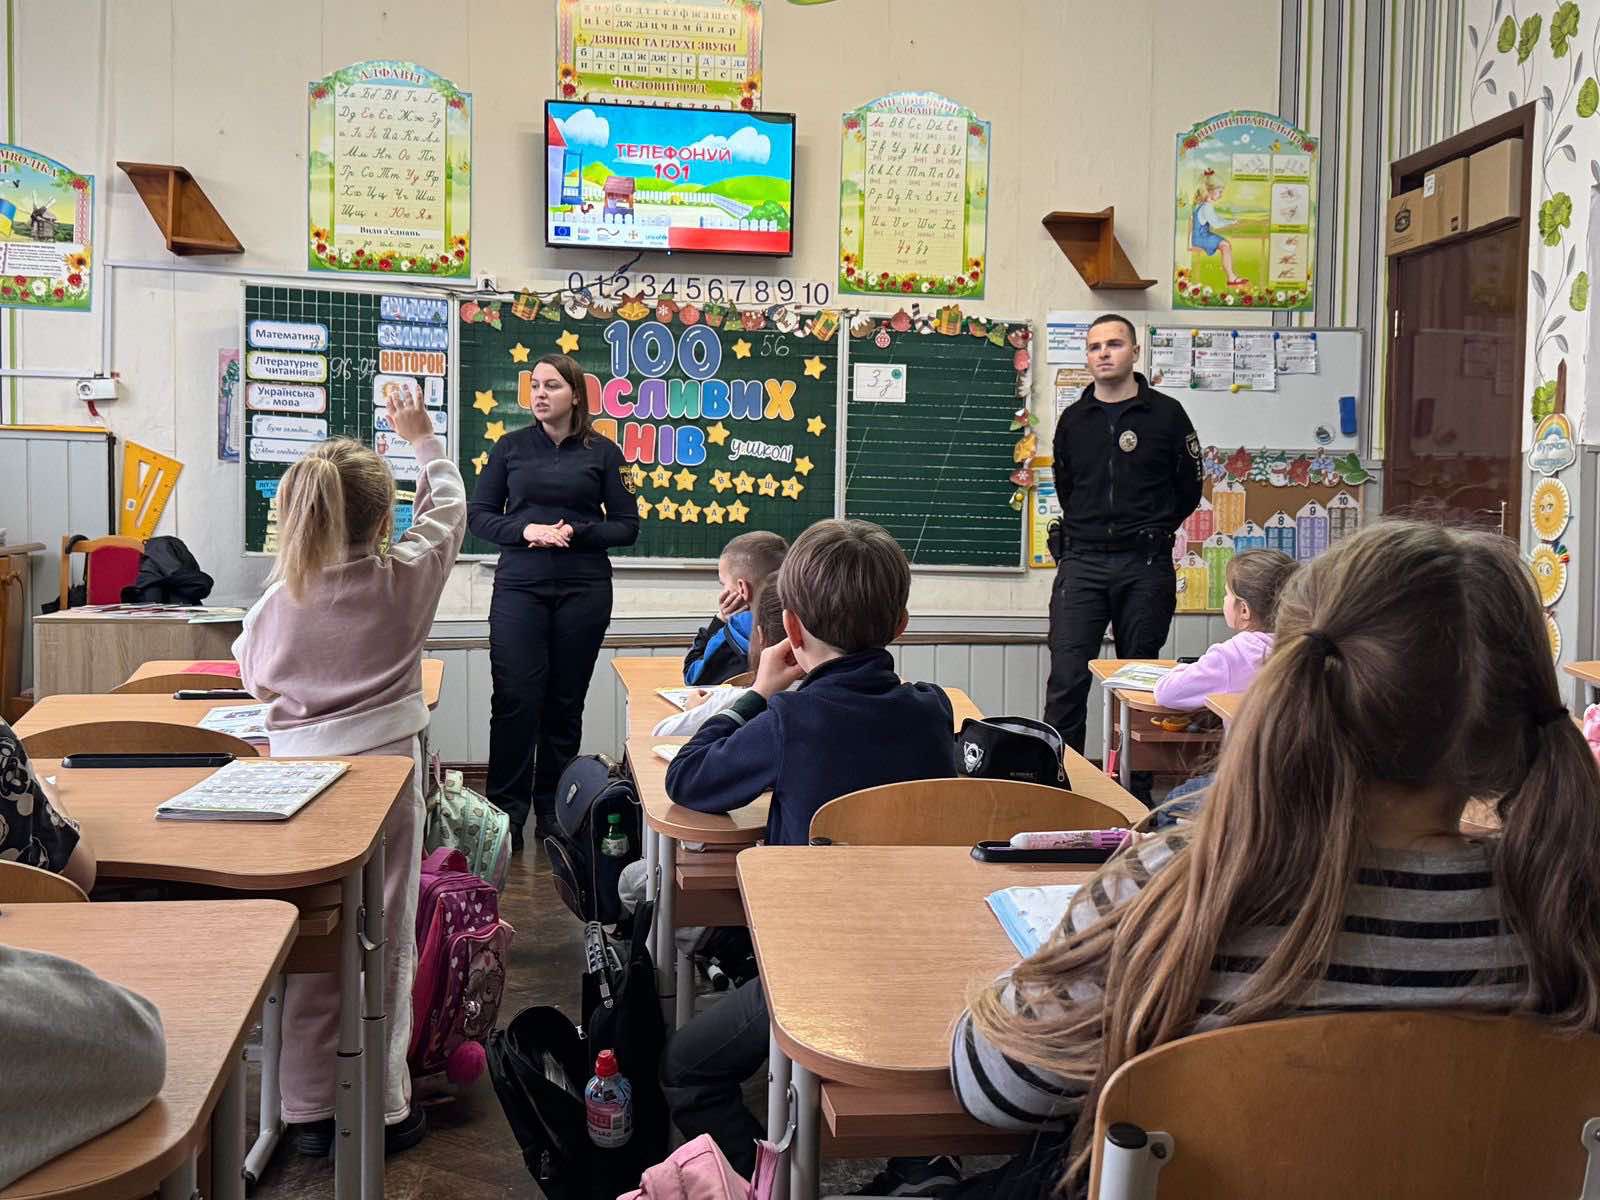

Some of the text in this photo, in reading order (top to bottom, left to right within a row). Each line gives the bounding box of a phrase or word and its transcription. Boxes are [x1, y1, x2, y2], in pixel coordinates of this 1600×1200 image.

[643, 38, 657, 47] ТА
[661, 39, 695, 50] ГЛУХІ
[697, 41, 736, 53] ЗВУКИ
[612, 79, 706, 95] ЧИСЛОВИЙ РЯД
[615, 143, 732, 161] ТЕЛЕФОНУЙ
[654, 162, 689, 180] 101
[568, 271, 584, 293] 0
[614, 276, 630, 296] 2
[641, 275, 656, 297] 3
[661, 277, 678, 296] 4
[686, 278, 701, 300] 5
[708, 278, 724, 300] 6
[730, 280, 746, 302] 7
[755, 280, 770, 302] 8
[777, 279, 794, 302] 9
[802, 282, 830, 305] 10
[255, 329, 321, 341] Математика
[604, 320, 722, 380] 100
[255, 356, 319, 369] Літературне
[381, 351, 444, 374] ВІВТОРОК
[265, 366, 309, 377] читання
[257, 386, 315, 398] Українська
[517, 370, 797, 420] СЛИВИХ
[272, 399, 300, 407] мова
[1338, 496, 1348, 506] 10
[1309, 507, 1316, 516] 9
[1278, 516, 1284, 526] 8
